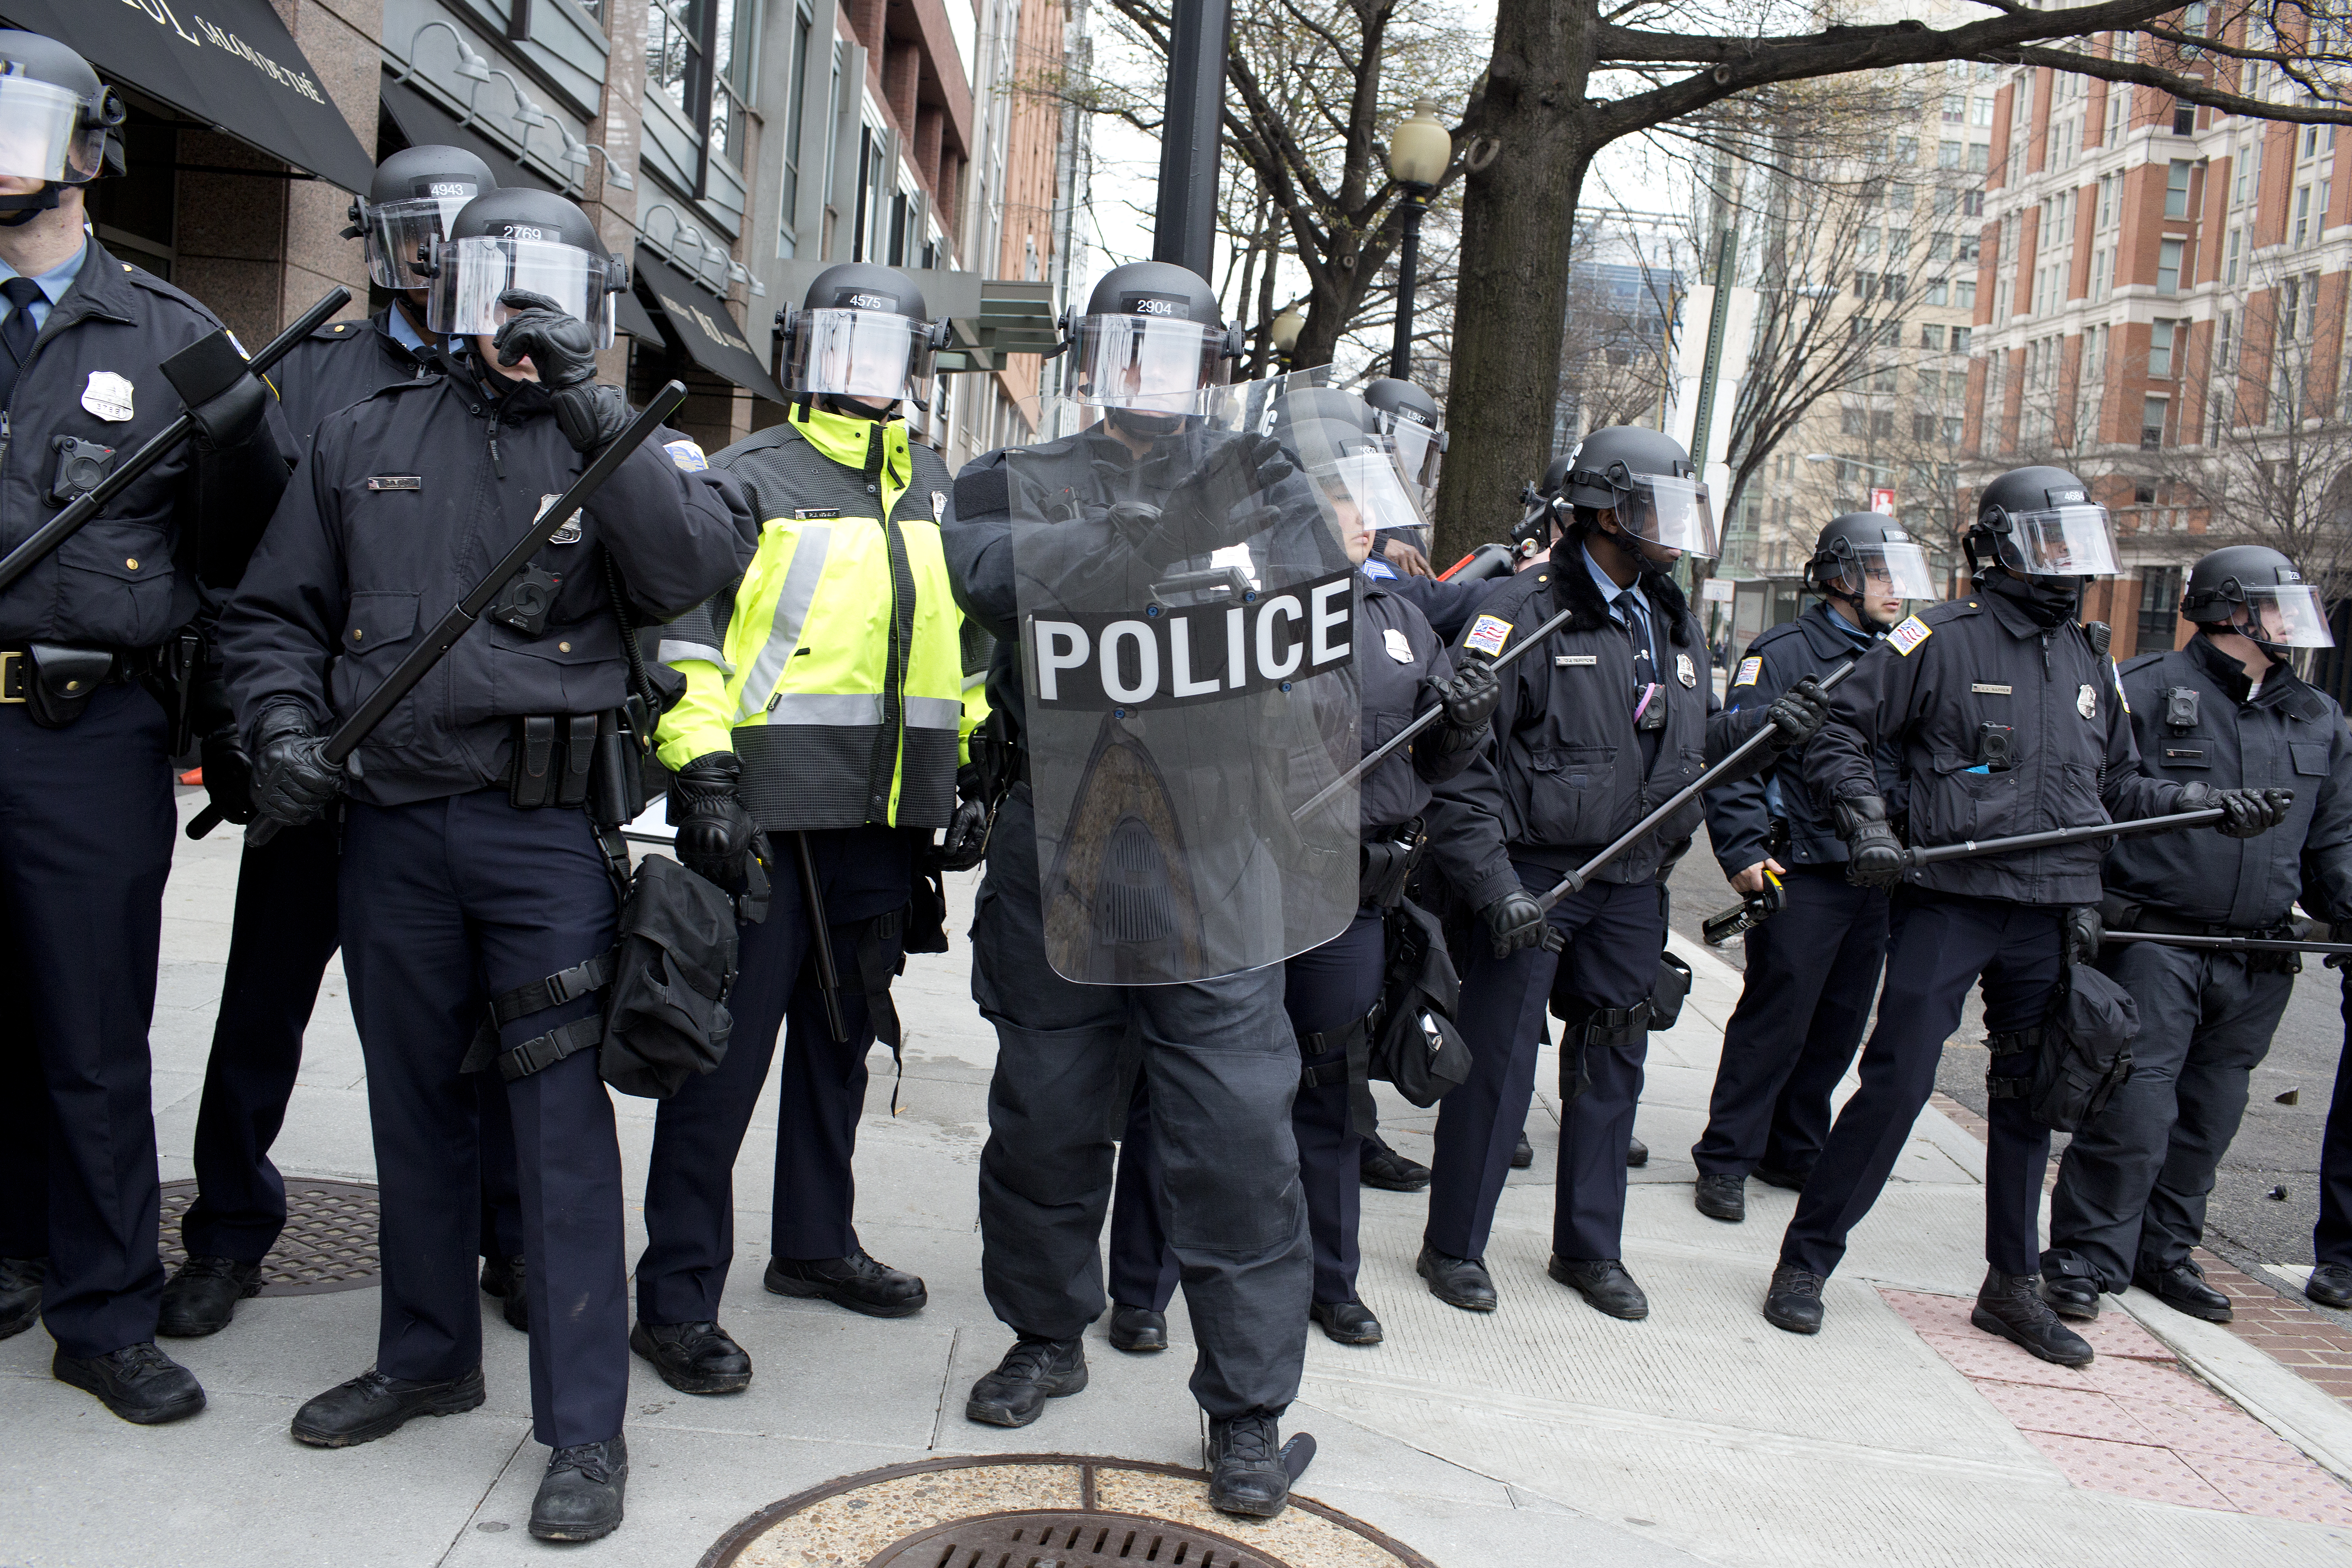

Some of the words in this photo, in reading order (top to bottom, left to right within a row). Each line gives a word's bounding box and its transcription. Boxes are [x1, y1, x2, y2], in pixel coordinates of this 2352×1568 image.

[194, 15, 265, 71] SALON
[255, 51, 290, 86] DE
[280, 66, 325, 105] THÉ
[431, 184, 464, 196] 4943
[503, 225, 542, 240] 2769
[849, 295, 881, 309] 4575
[1137, 300, 1172, 315] 2904
[1407, 410, 1426, 424] L347
[2064, 491, 2085, 501] 4684
[1034, 577, 1350, 704] POLICE
